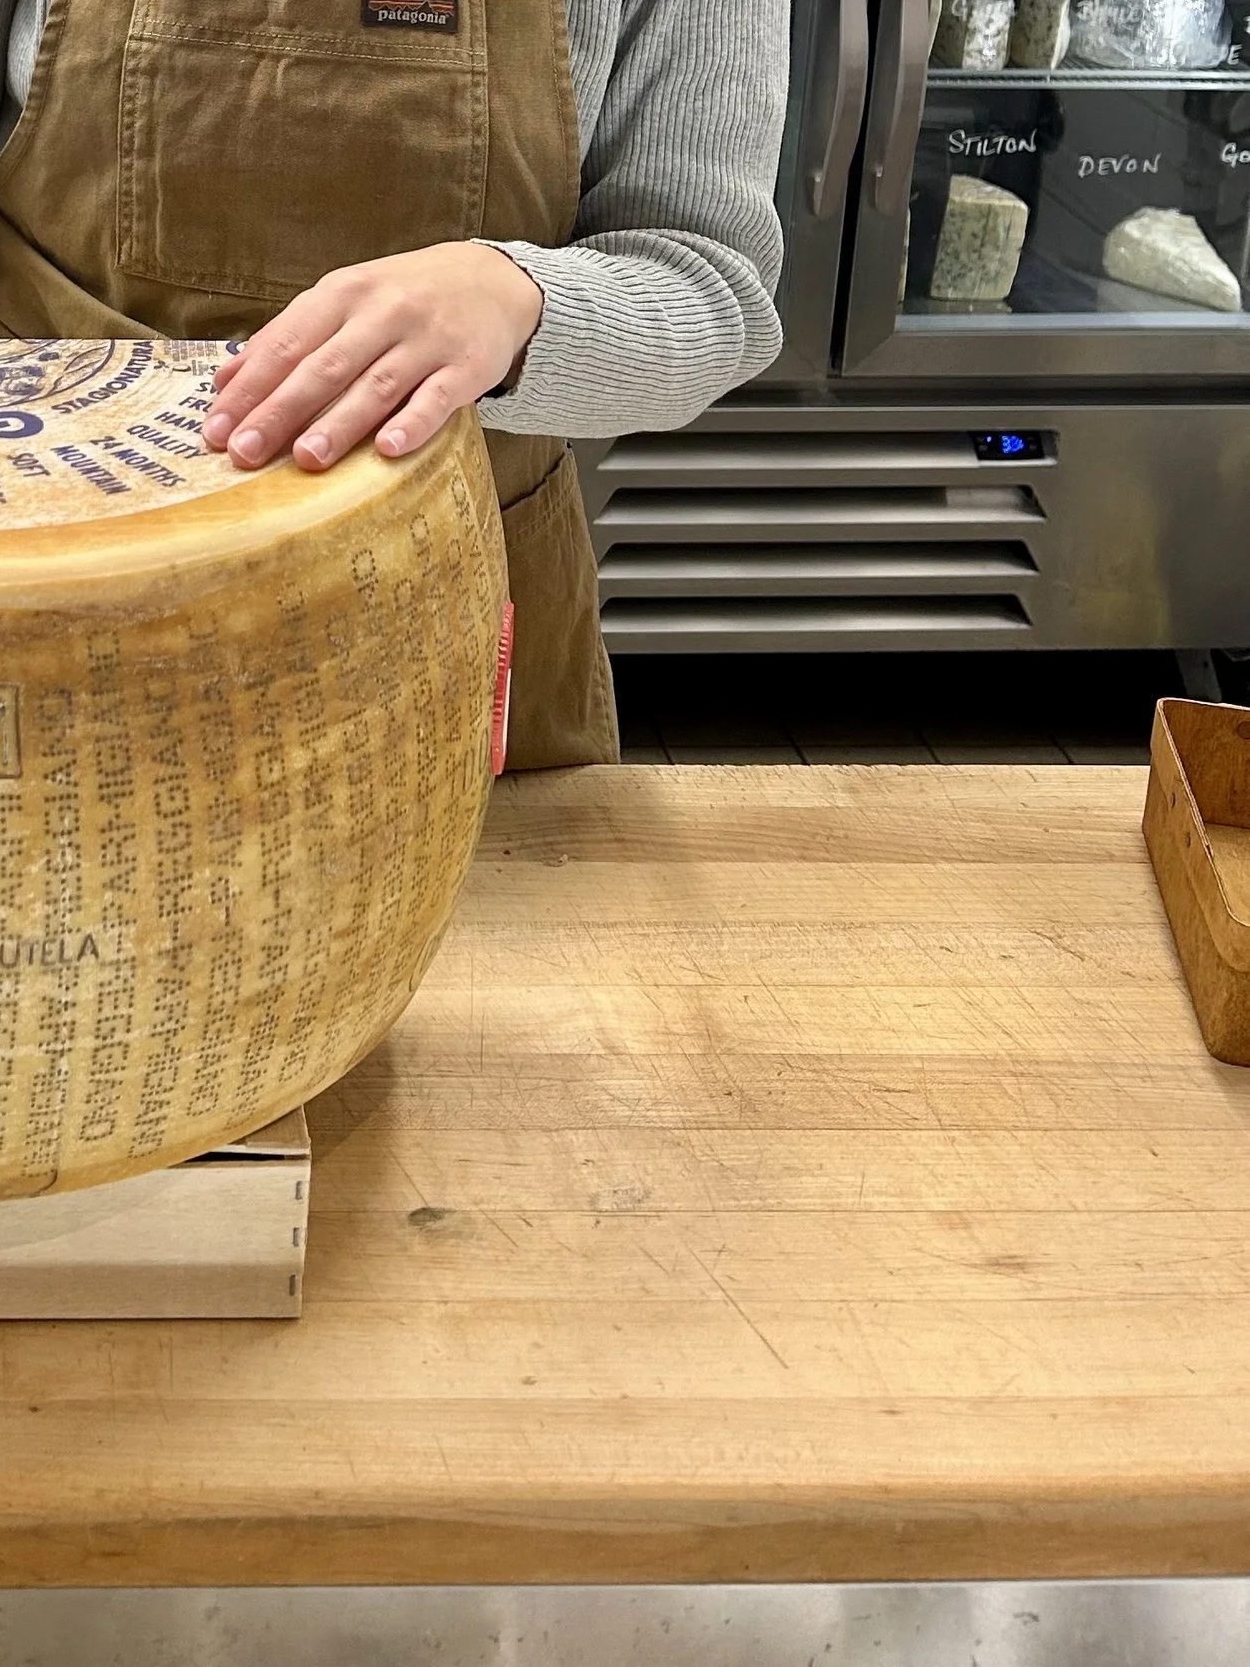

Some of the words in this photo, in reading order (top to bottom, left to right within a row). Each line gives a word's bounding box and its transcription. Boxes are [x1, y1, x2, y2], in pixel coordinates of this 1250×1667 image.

[378, 9, 447, 24] patagonia
[948, 129, 1037, 156] STILTON
[1078, 153, 1162, 179] DEVON
[90, 436, 115, 451] 24
[112, 448, 187, 488] MONTHS
[125, 424, 209, 459] QUALITY
[7, 452, 51, 478] SOFT
[50, 445, 131, 495] MOUNTAIN
[86, 629, 137, 930] PARMIGIANO
[141, 670, 194, 919] REGGIANO
[34, 688, 82, 936] REGGIANO
